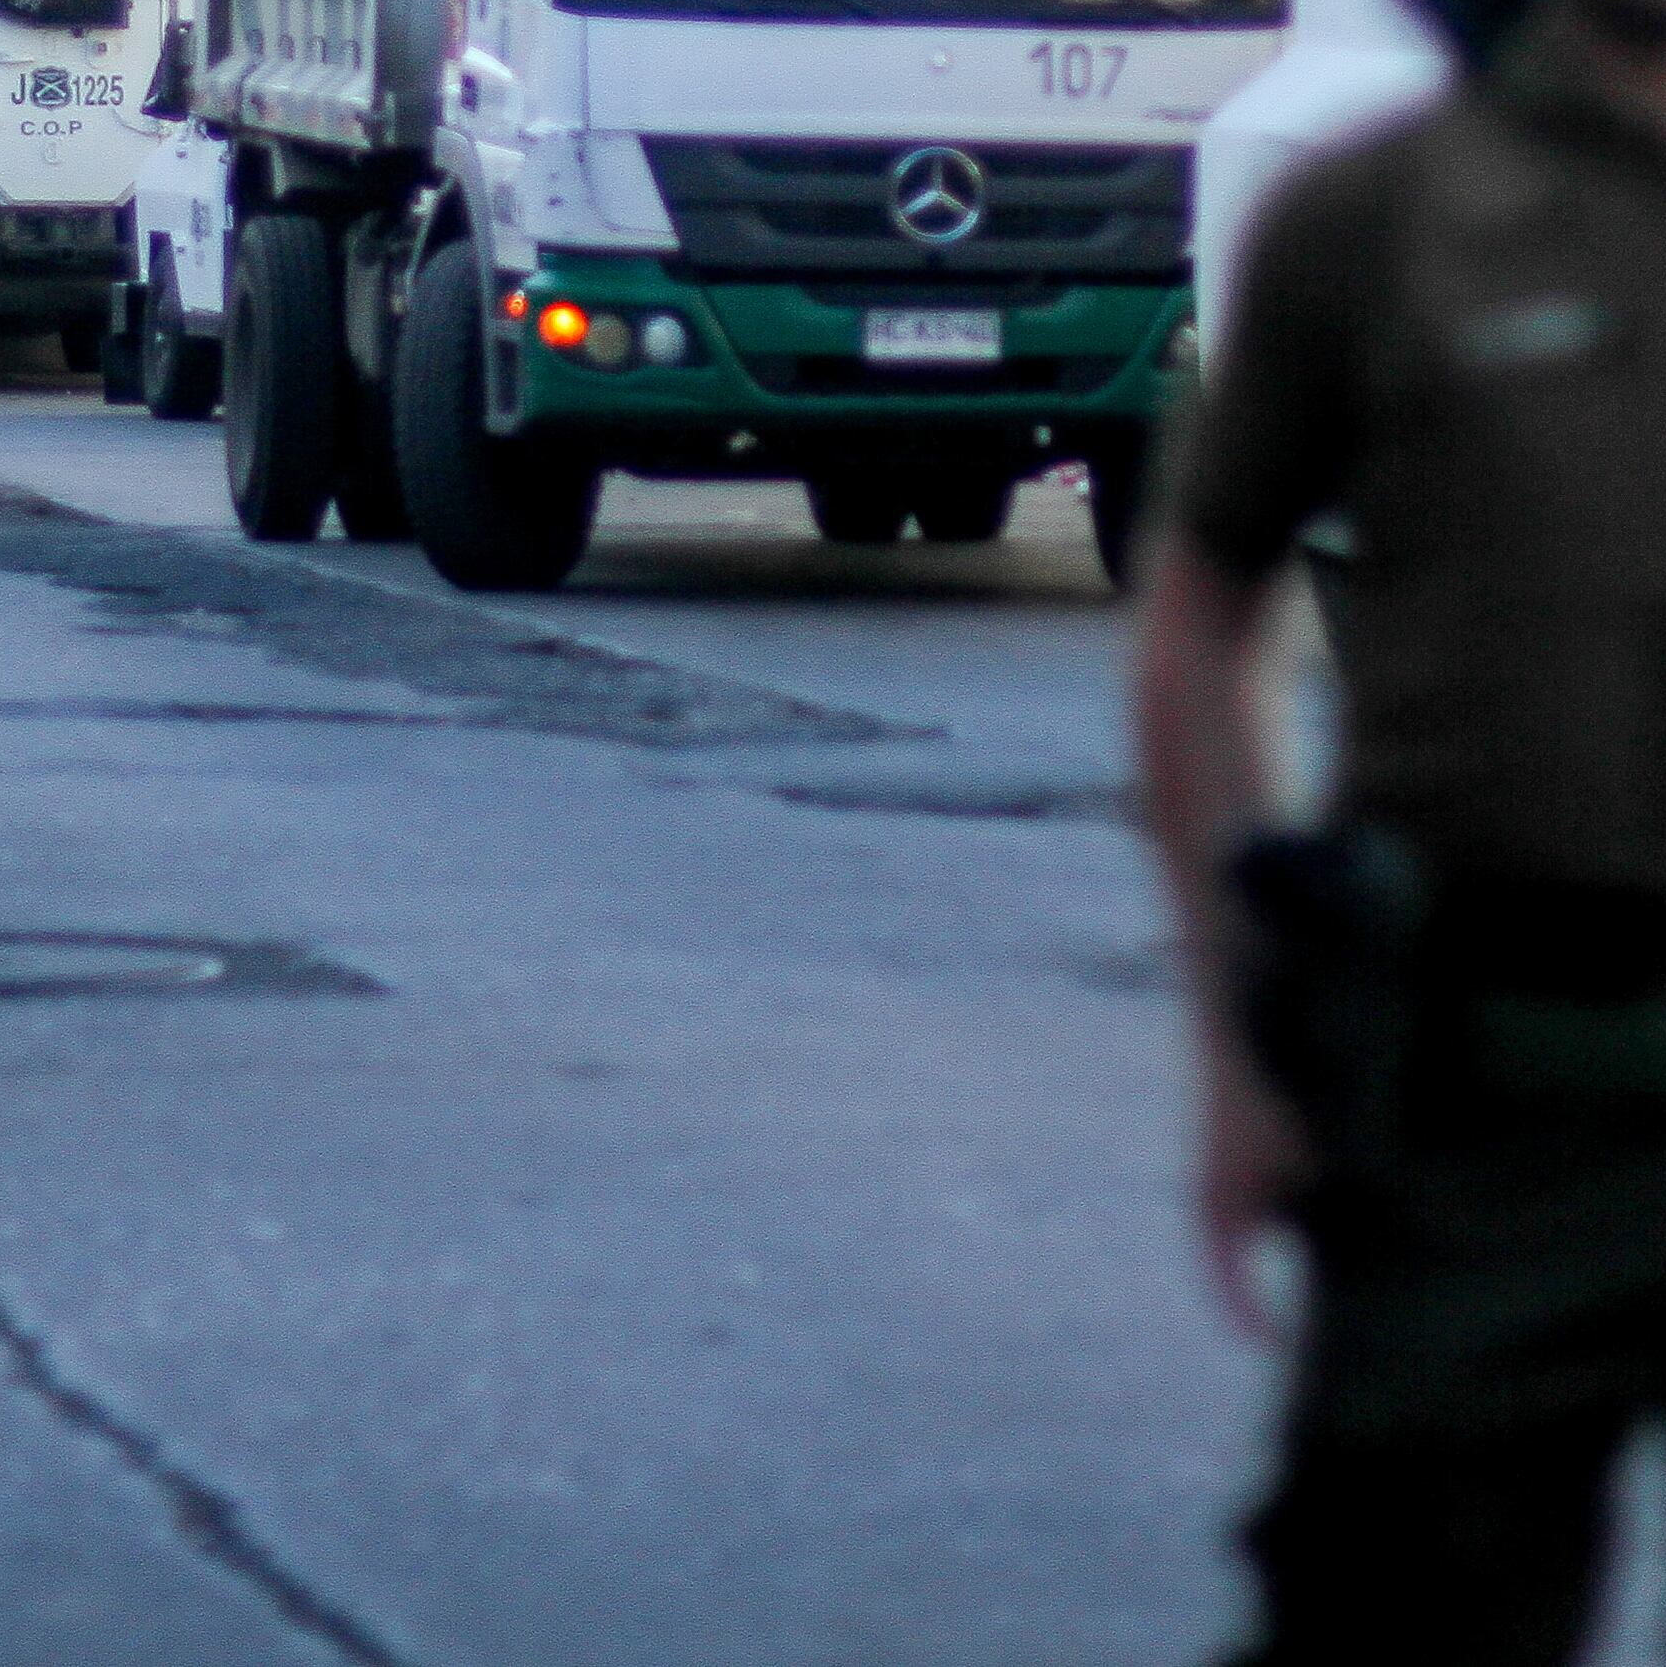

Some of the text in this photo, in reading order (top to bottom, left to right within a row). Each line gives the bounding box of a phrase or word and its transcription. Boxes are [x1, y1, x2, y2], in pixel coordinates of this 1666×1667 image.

[10, 73, 124, 106] J 1225
[1026, 40, 1128, 101] 107
